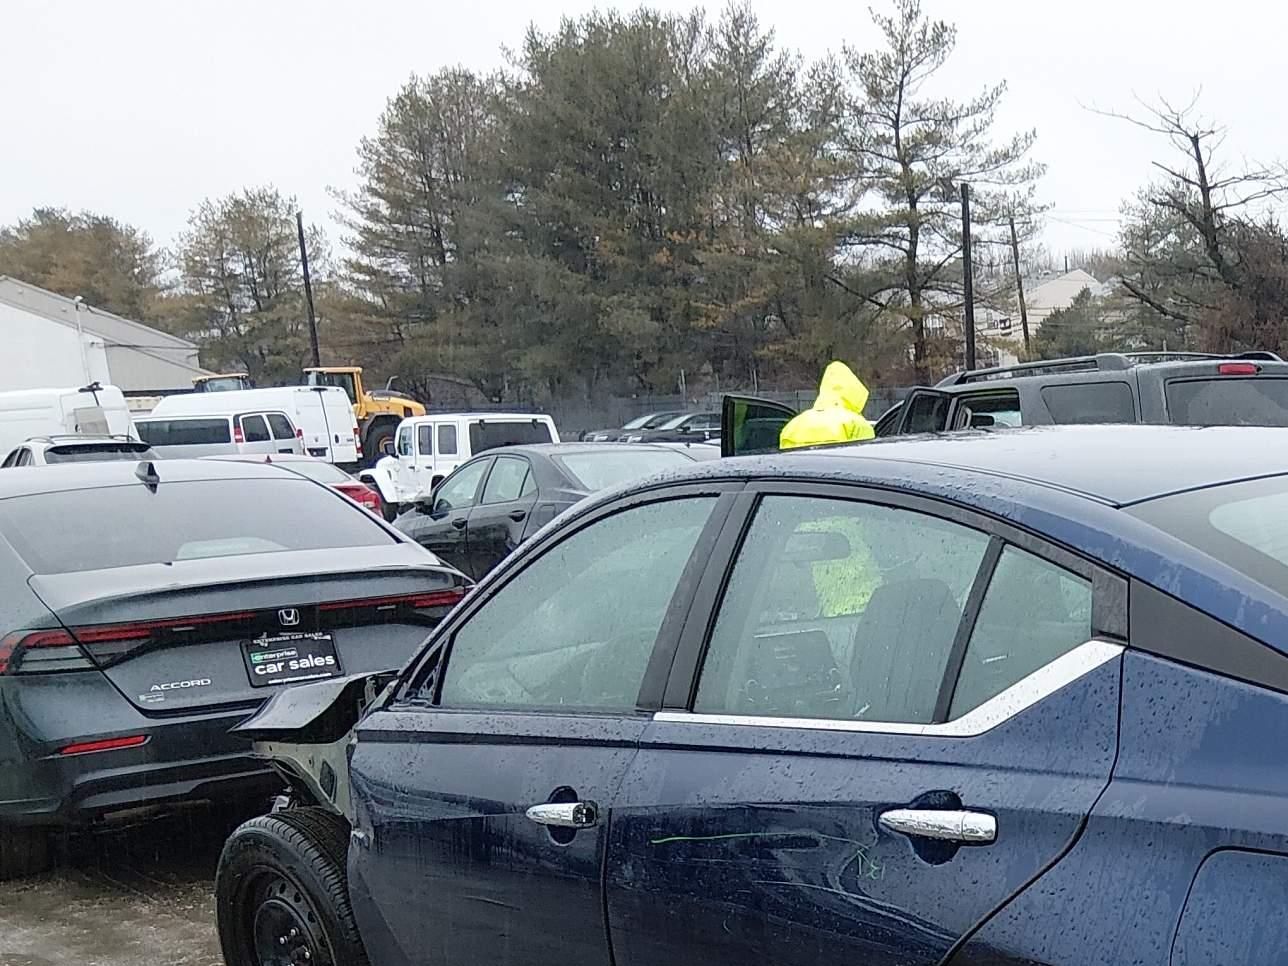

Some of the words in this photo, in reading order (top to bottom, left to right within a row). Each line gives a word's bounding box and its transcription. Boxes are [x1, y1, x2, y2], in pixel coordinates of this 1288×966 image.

[254, 649, 296, 661] enterprise
[254, 661, 285, 675] car
[288, 654, 335, 670] sales
[150, 678, 212, 692] ACCORD
